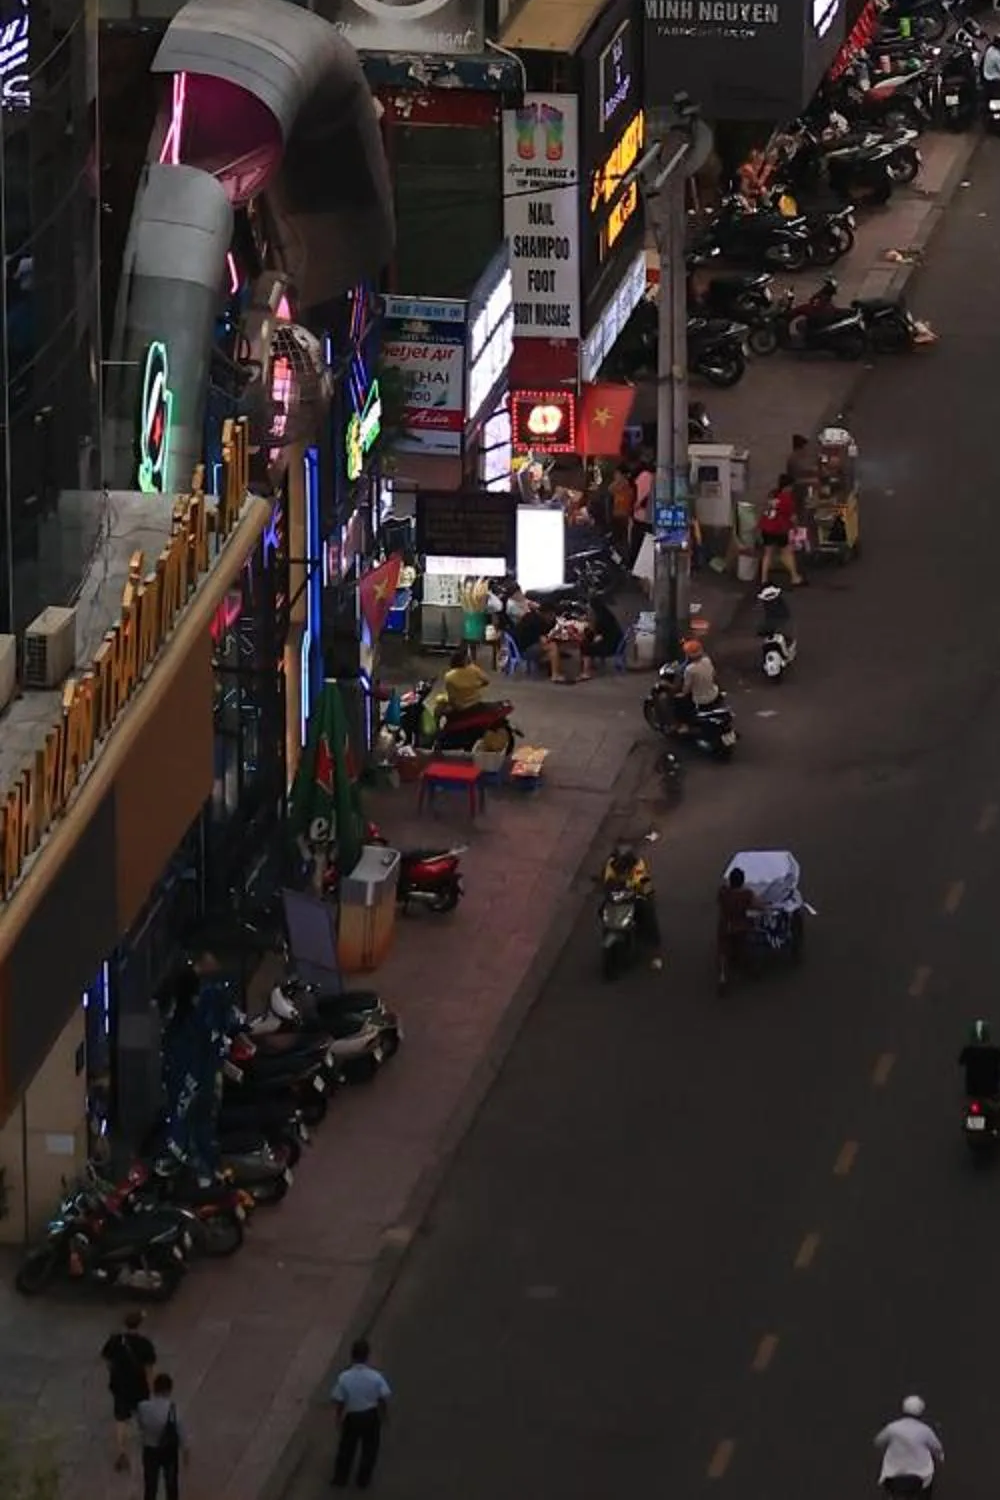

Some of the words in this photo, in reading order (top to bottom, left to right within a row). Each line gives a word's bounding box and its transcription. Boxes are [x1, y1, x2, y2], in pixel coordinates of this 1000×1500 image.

[645, 0, 693, 20] MINH
[699, 1, 779, 24] NGUYEN
[528, 201, 555, 226] NAIL
[514, 234, 570, 260] SHAMPOO
[527, 269, 556, 293] FOOT
[535, 303, 571, 327] MASSAGE
